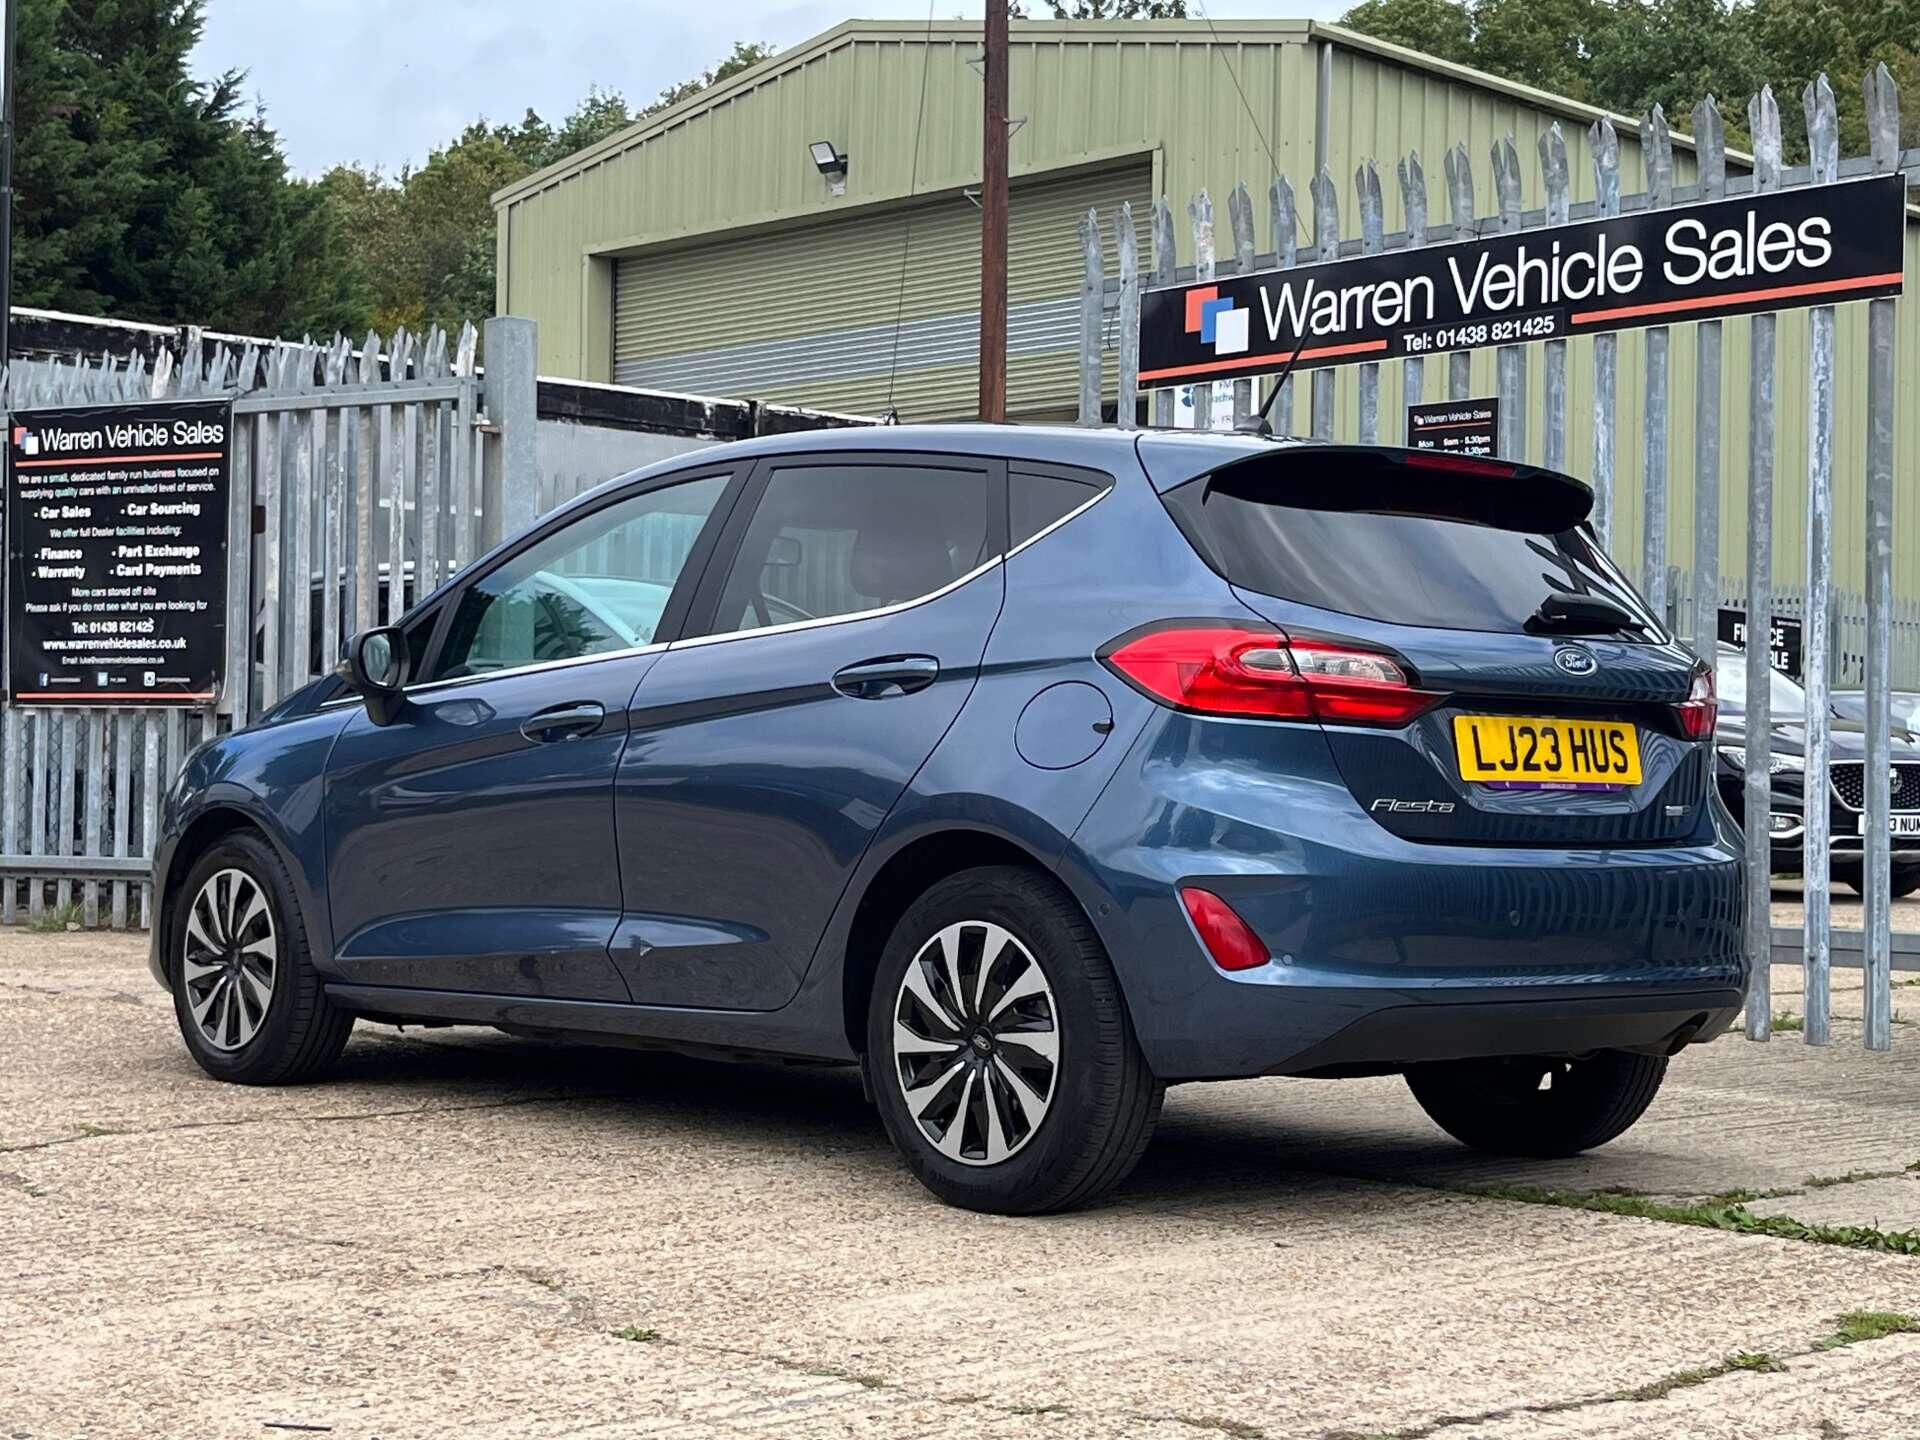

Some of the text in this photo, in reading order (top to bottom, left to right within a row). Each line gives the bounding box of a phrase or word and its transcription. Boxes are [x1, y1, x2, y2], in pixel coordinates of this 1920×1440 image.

[1260, 210, 1832, 341] Warren Vehicle Sales
[1404, 314, 1556, 351] Tel: 01438 821425
[41, 420, 224, 451] Warren Vehicle Sales
[18, 474, 29, 484] We
[30, 475, 42, 484] are
[43, 475, 48, 483] a
[70, 471, 106, 482] dedicated
[106, 470, 128, 482] family
[129, 471, 142, 480] run
[143, 469, 176, 479] business
[177, 466, 207, 477] focused
[208, 468, 219, 476] on
[21, 487, 54, 499] supplying
[54, 486, 78, 498] quality
[79, 487, 95, 496] cars
[95, 485, 111, 495] with
[112, 486, 122, 495] an
[159, 483, 176, 493] level
[177, 482, 186, 492] of
[186, 482, 216, 492] service.
[41, 505, 92, 519] Car Sales
[127, 501, 200, 516] Car Sourcing
[50, 525, 182, 538] We offer full Dealer facilities including:
[41, 547, 83, 560] Finance
[118, 544, 201, 559] Part Exchange
[38, 565, 86, 579] Warranty
[116, 563, 202, 578] Card Payments
[71, 586, 157, 597] More cars stored off site
[25, 600, 208, 614] Please ask if you do not see what you are looking for
[72, 619, 155, 634] Tel: 01438 821425
[43, 636, 187, 650] www.warrenvehiclesales.co.uk
[1471, 724, 1629, 774] LJ23 HUS
[1370, 798, 1456, 813] Fiesta
